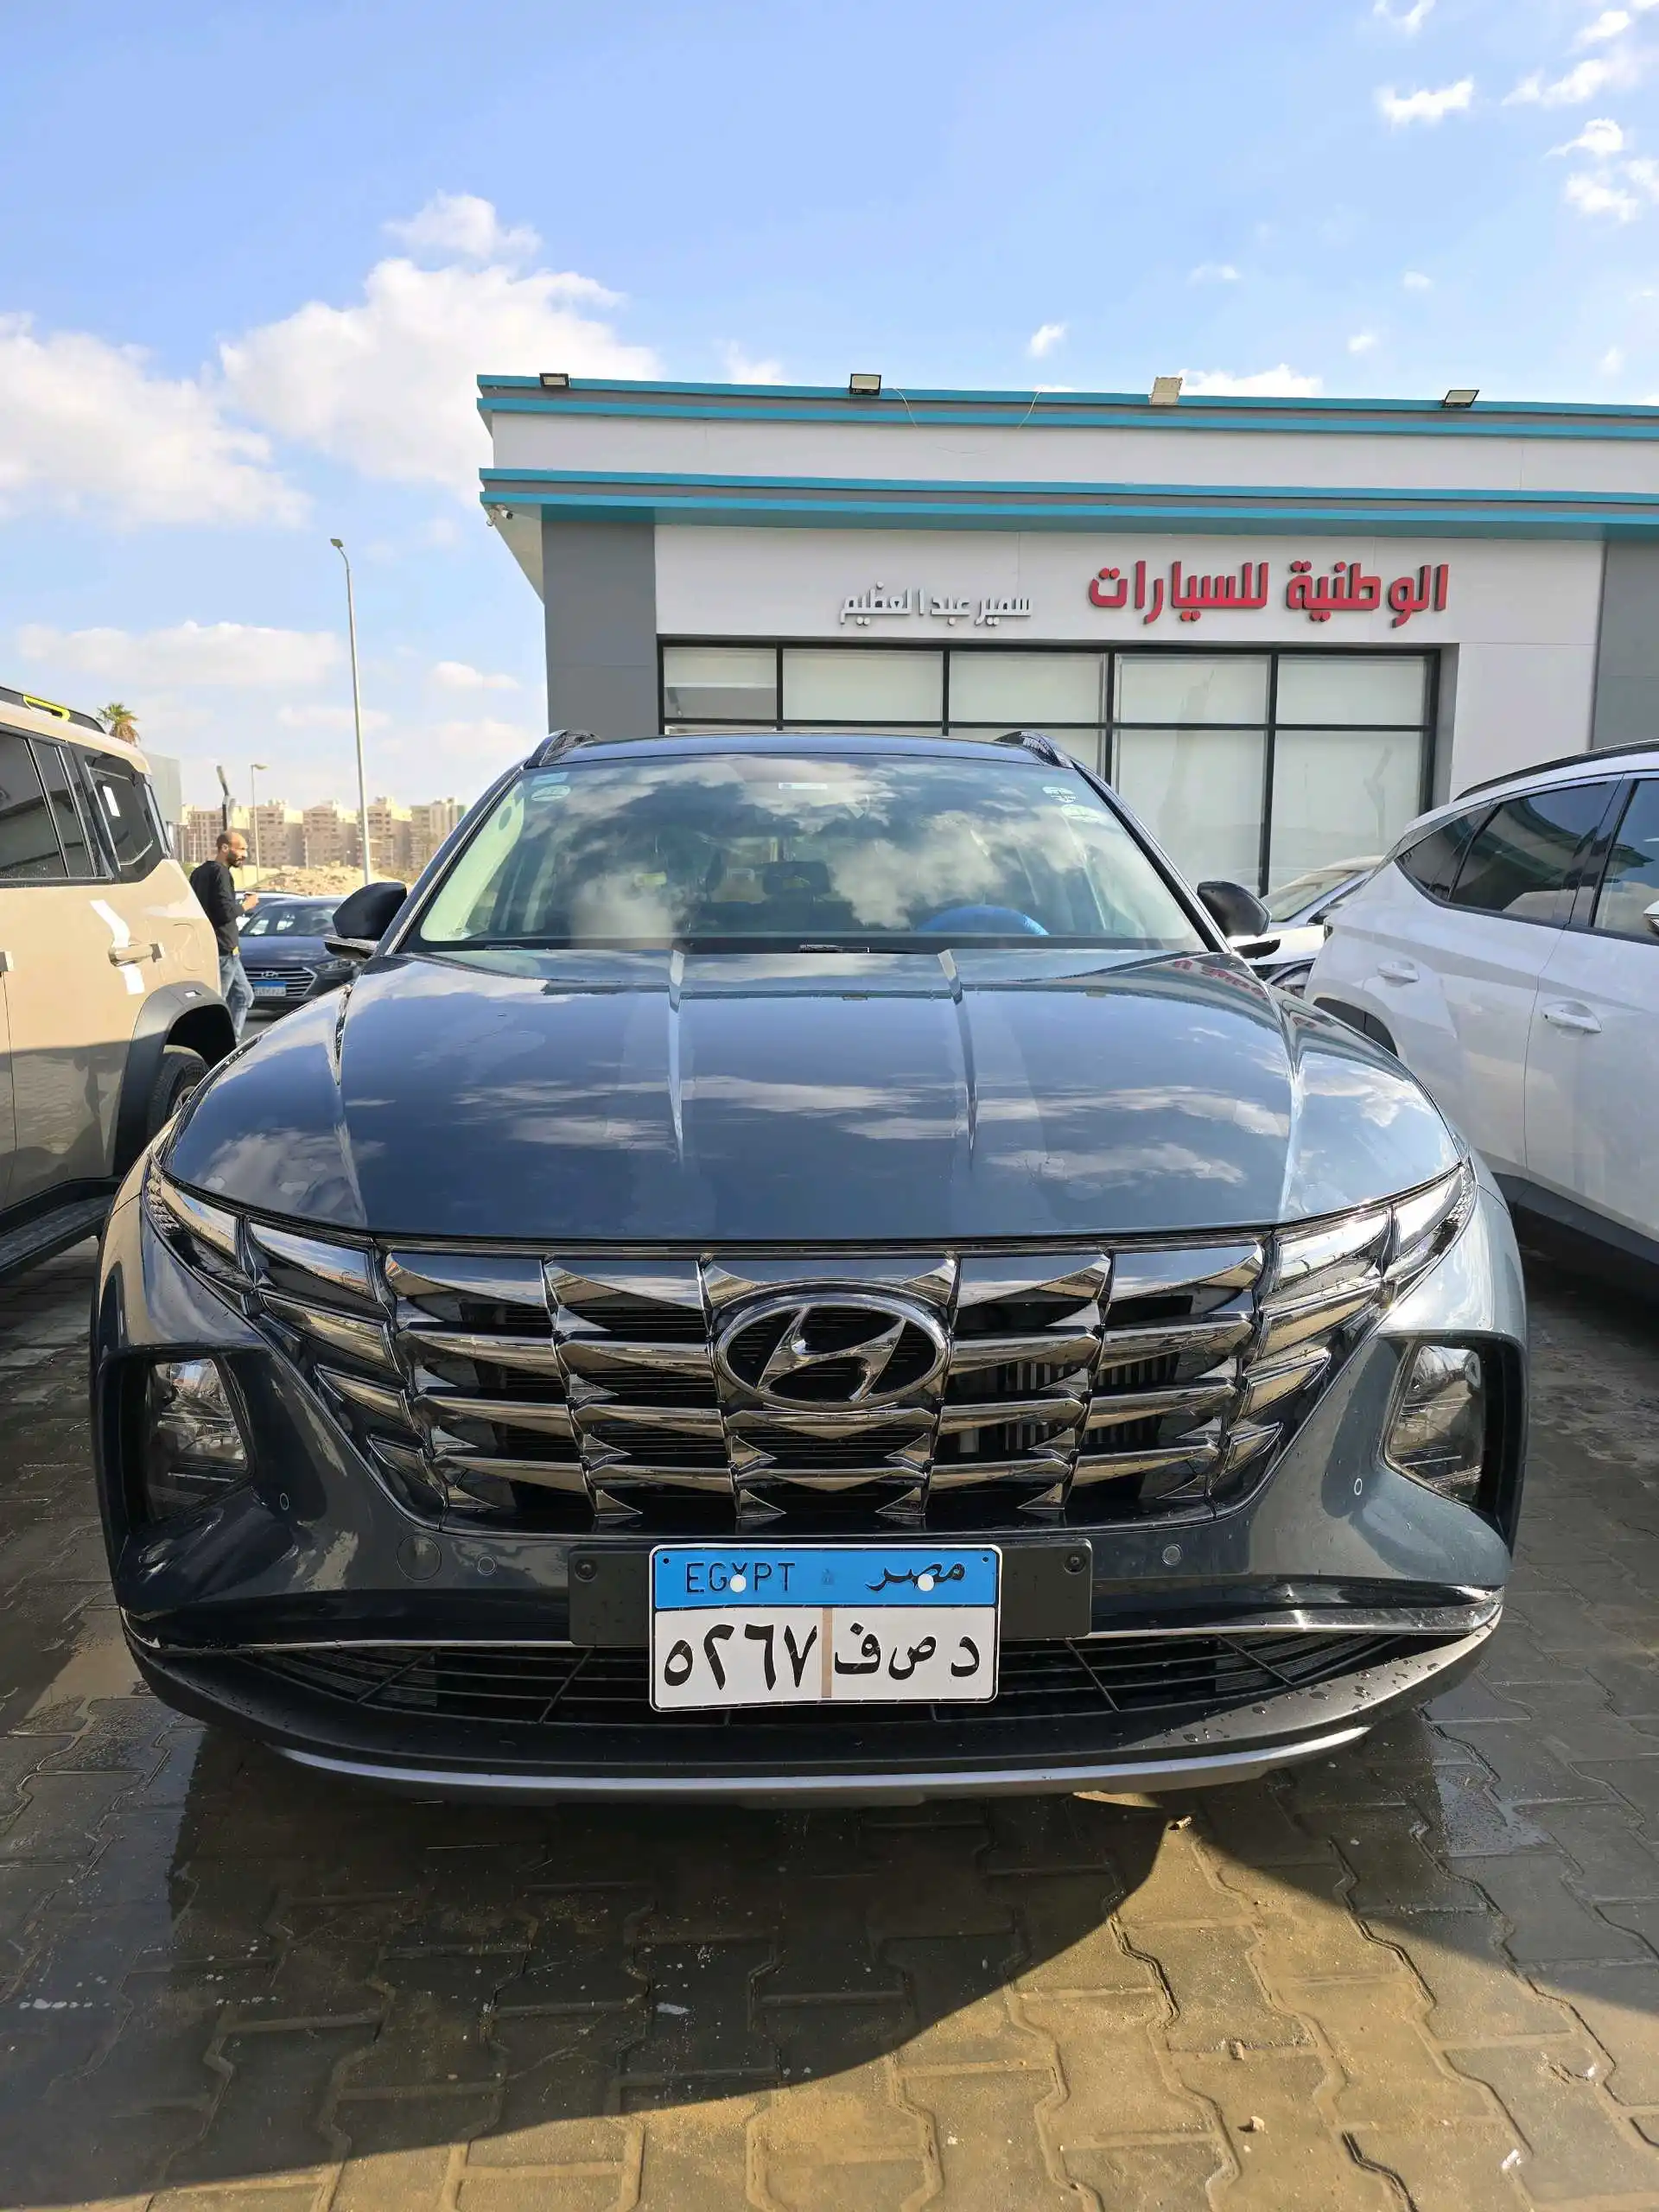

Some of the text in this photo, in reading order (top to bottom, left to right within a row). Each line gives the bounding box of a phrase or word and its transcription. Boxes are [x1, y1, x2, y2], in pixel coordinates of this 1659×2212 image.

[839, 581, 1032, 626] سمير عبد العظيم
[1089, 560, 1449, 628] الوطنية للسيارات
[686, 1562, 796, 1593] EGYPT
[865, 1563, 966, 1592] مصر
